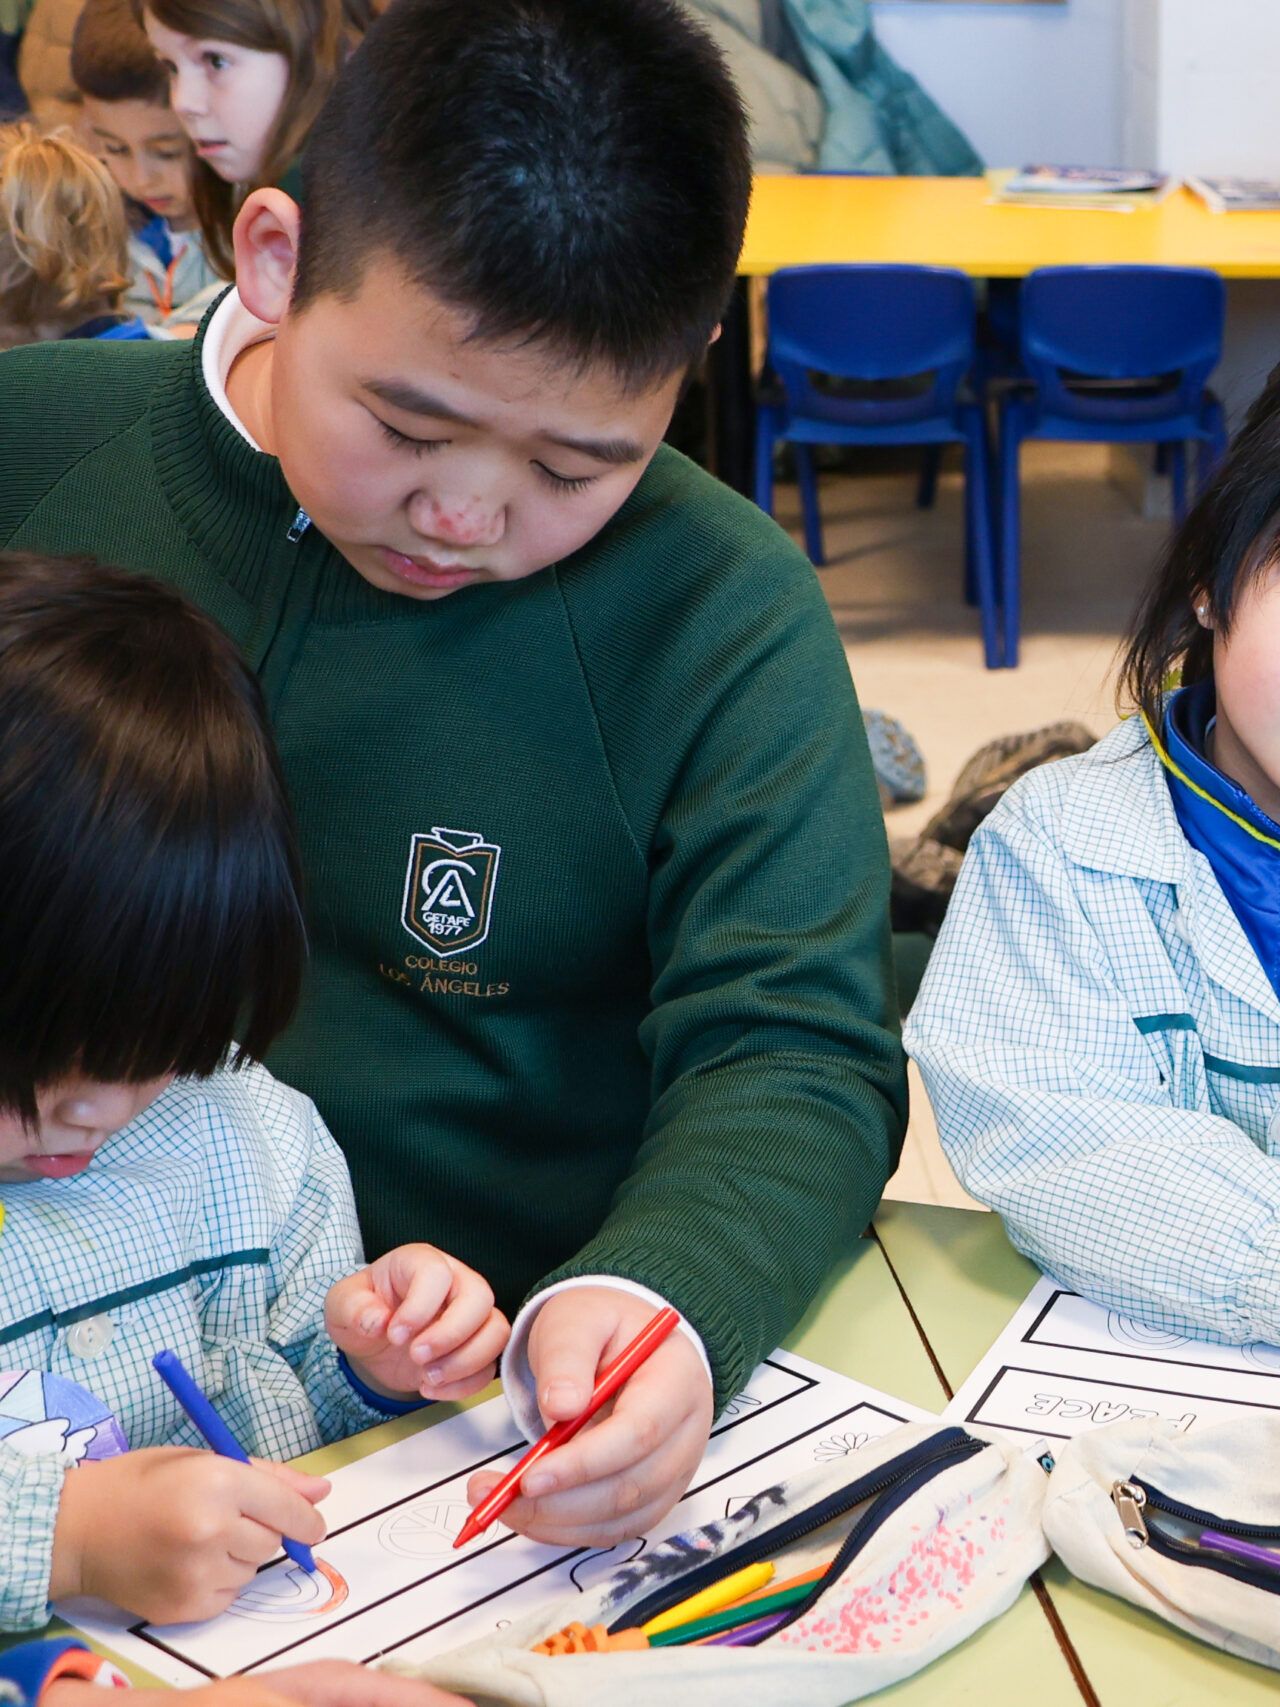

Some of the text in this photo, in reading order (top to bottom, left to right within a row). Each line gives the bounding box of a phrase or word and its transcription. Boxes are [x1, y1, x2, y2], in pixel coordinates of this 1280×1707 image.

[422, 912, 471, 927] GETAFE
[428, 923, 463, 935] 1977
[405, 955, 478, 975] COLEGIO
[420, 972, 510, 997] ÁNGELES
